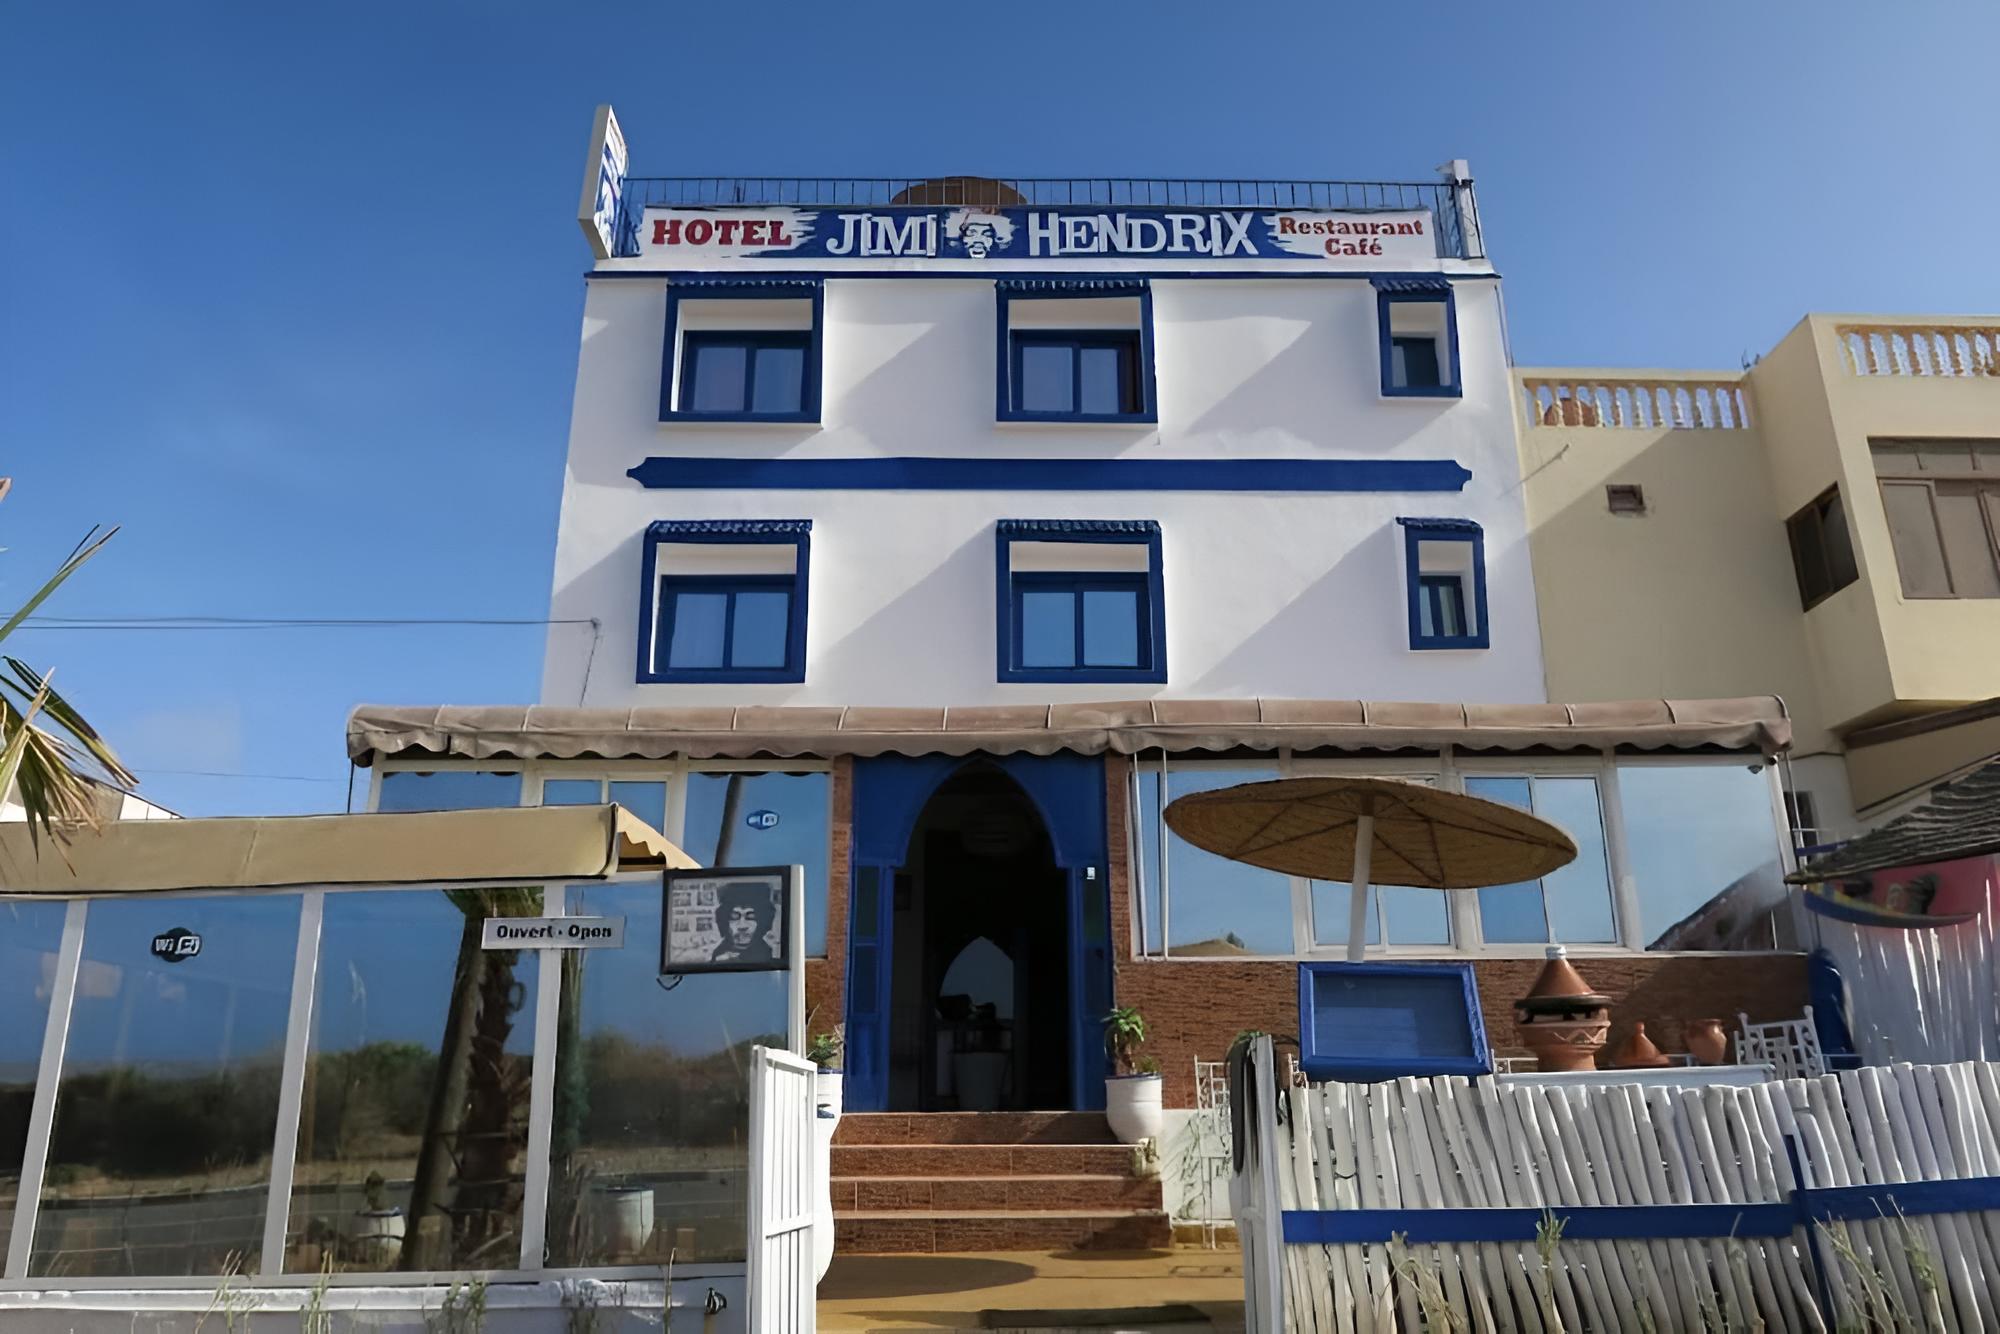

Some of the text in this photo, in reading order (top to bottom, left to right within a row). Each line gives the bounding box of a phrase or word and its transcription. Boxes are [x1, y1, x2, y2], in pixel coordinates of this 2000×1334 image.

[652, 211, 1259, 257] HOTEL JIMI HENDRIX
[1279, 217, 1424, 235] Restaurant
[1325, 238, 1383, 256] Café
[497, 924, 612, 940] Ouvert Open
